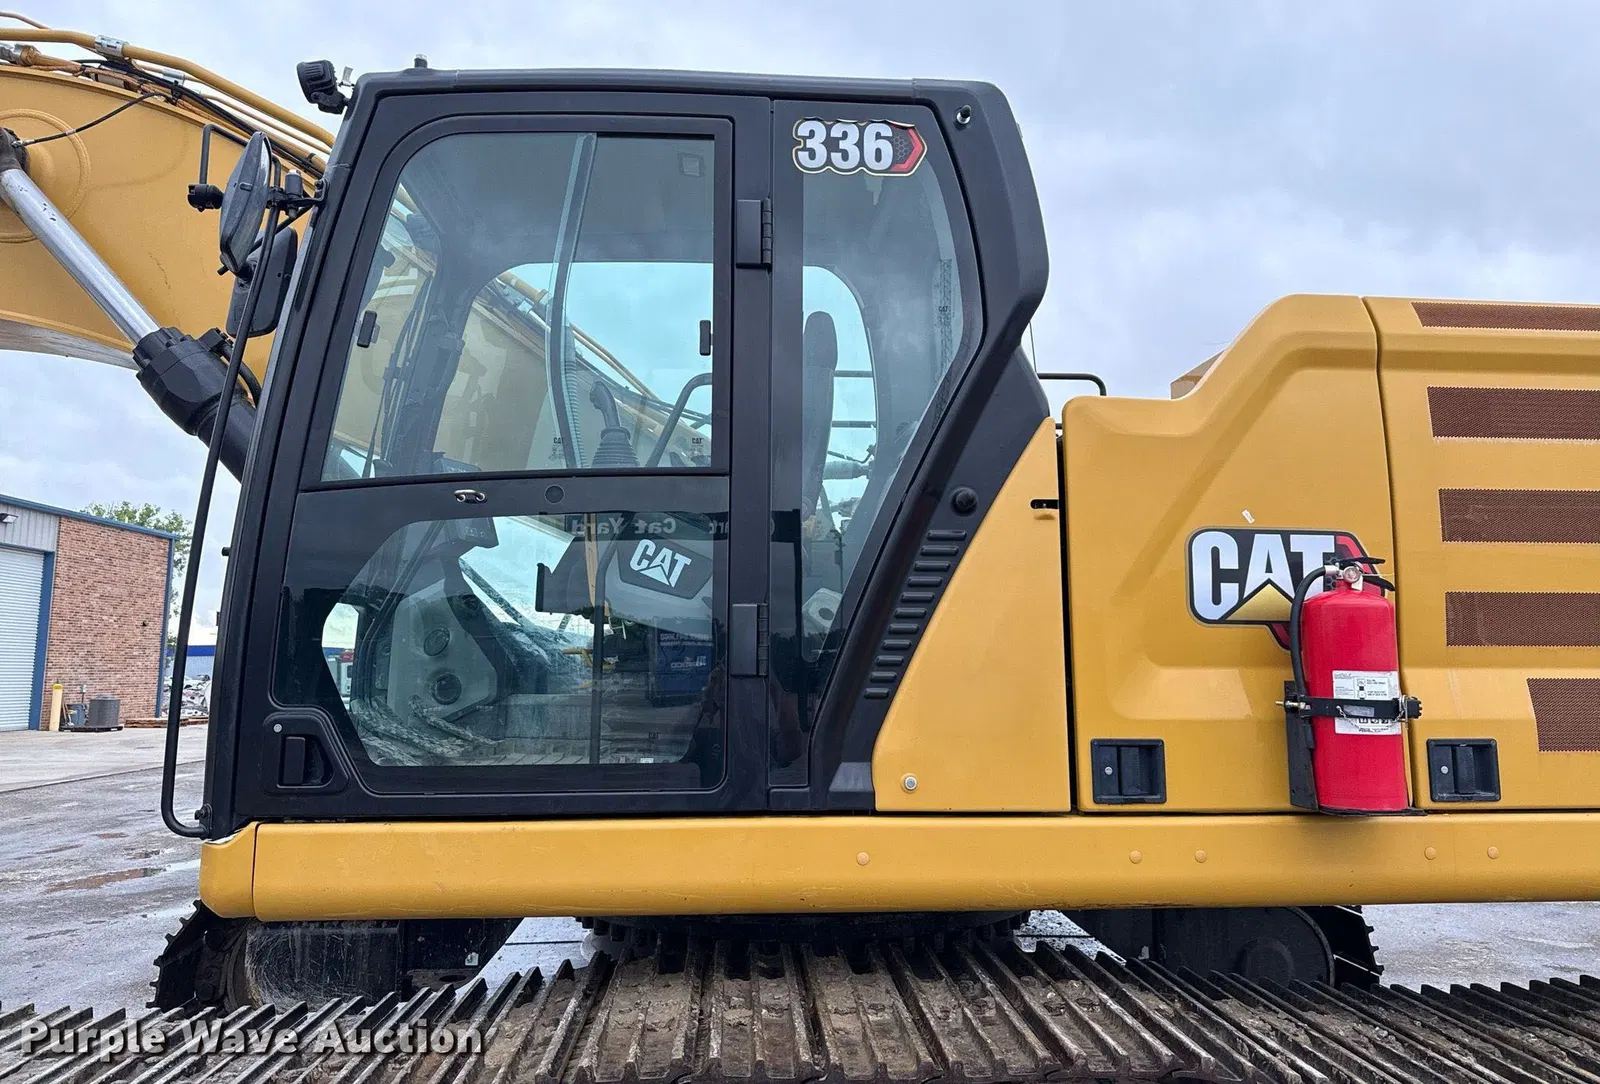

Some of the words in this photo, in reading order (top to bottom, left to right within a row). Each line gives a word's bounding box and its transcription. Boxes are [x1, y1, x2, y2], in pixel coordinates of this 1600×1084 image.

[797, 120, 894, 171] 336
[629, 538, 693, 588] CAT
[1191, 531, 1335, 620] CAT
